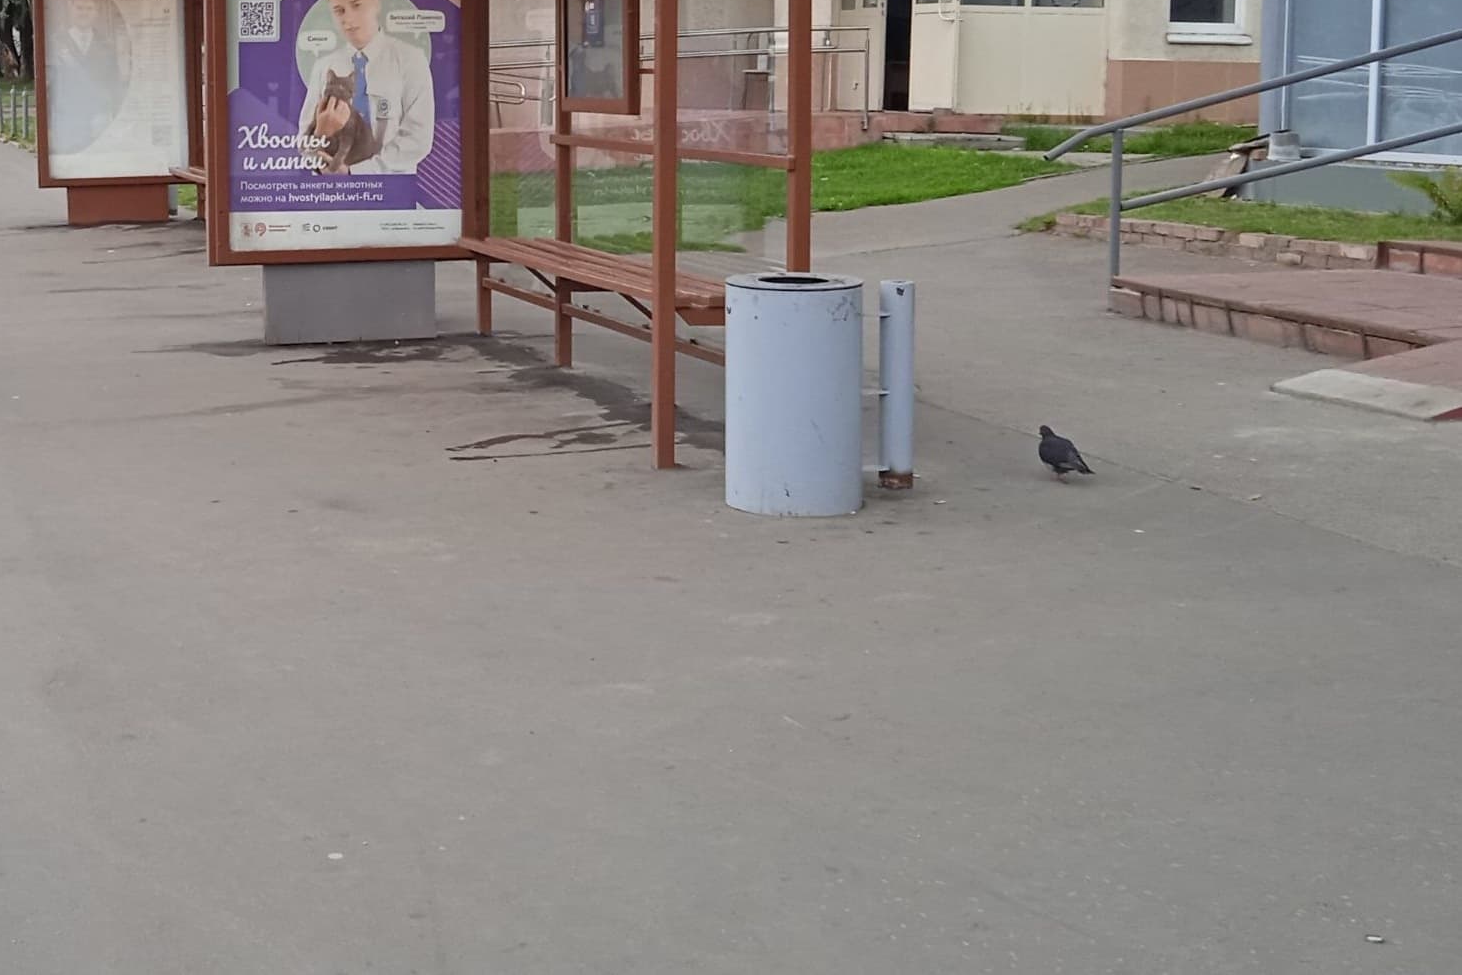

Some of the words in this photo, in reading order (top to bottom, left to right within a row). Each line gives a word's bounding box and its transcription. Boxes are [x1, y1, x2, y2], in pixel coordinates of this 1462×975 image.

[238, 123, 331, 149] Хвосты
[243, 156, 258, 171] и
[261, 155, 327, 171] лапки
[240, 180, 298, 192] Посмотреть
[300, 181, 334, 190] анкеты
[335, 181, 383, 189] животных
[240, 194, 273, 203] можно
[275, 194, 287, 202] на
[288, 192, 384, 204] hvostyilapki.wi-fi.ru
